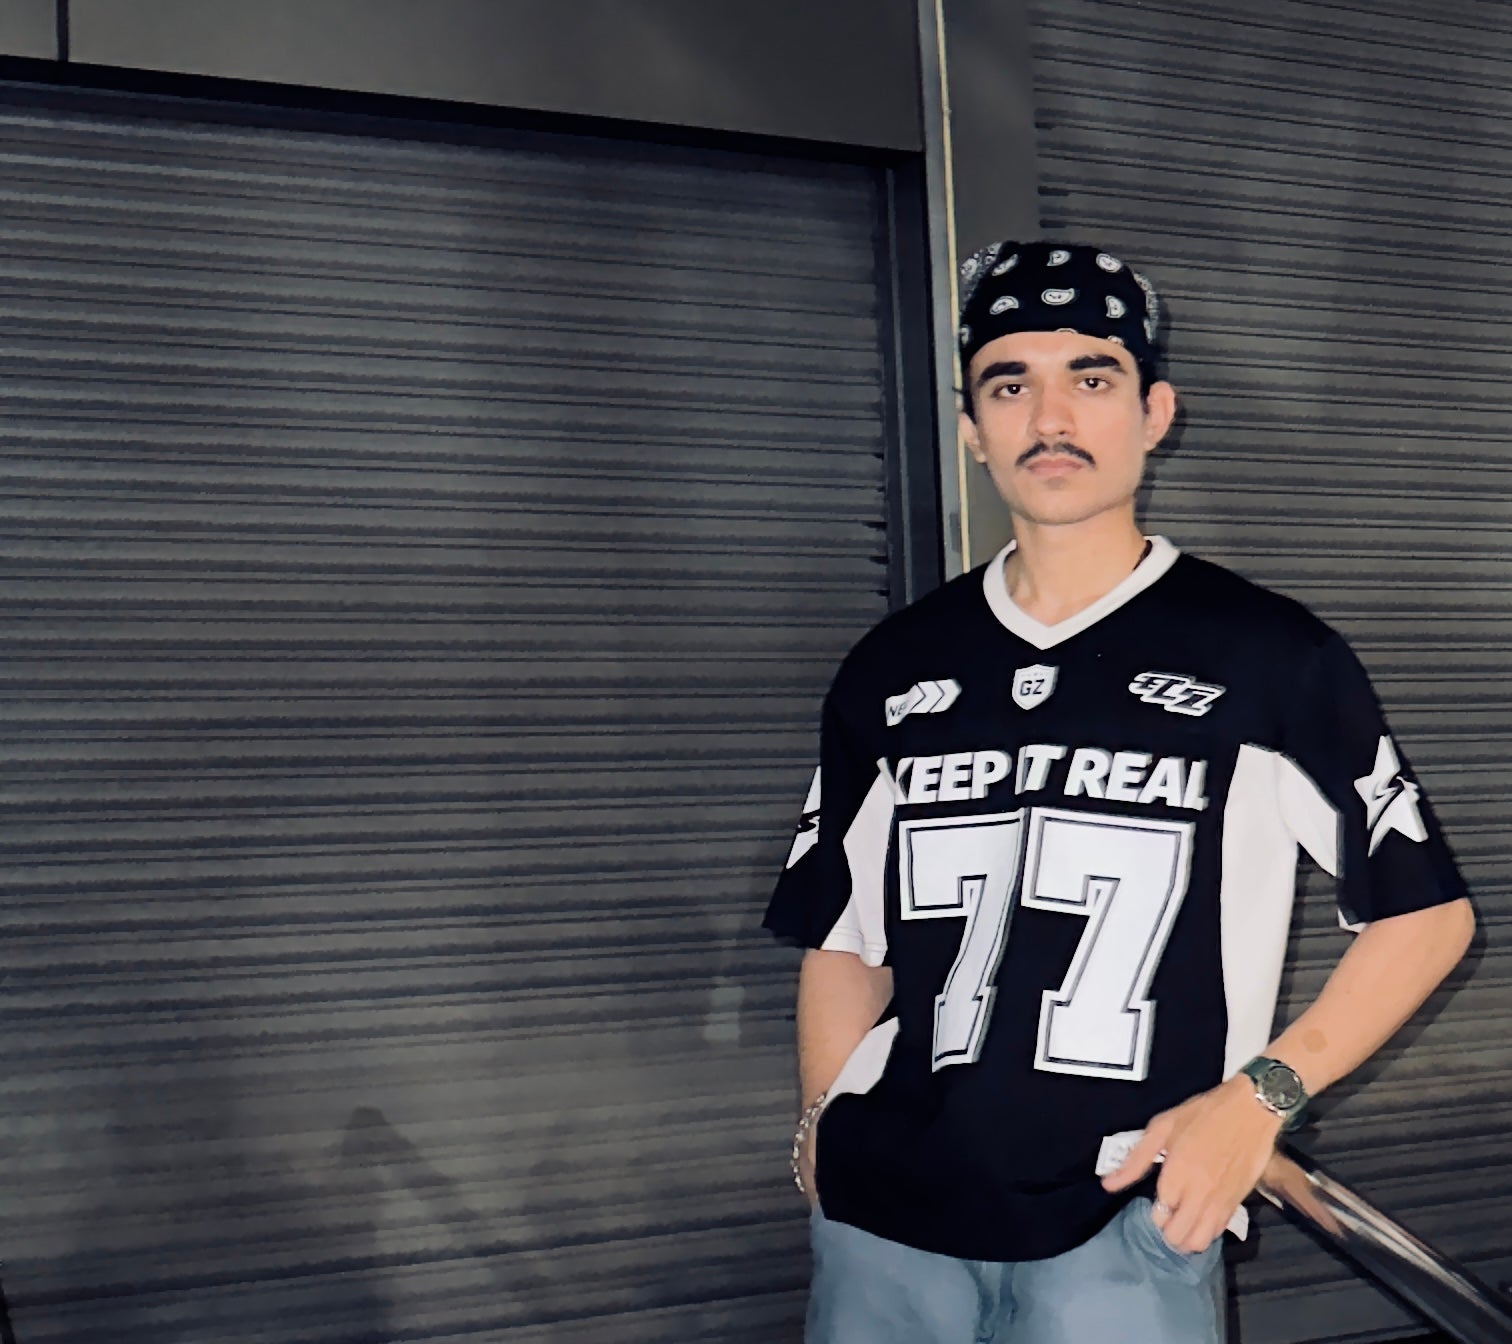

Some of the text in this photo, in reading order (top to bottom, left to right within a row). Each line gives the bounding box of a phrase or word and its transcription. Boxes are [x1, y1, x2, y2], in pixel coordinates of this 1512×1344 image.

[1020, 679, 1046, 697] GZ
[882, 750, 1012, 805] KEEP
[1063, 747, 1210, 811] REAL
[899, 806, 1196, 1082] 77
